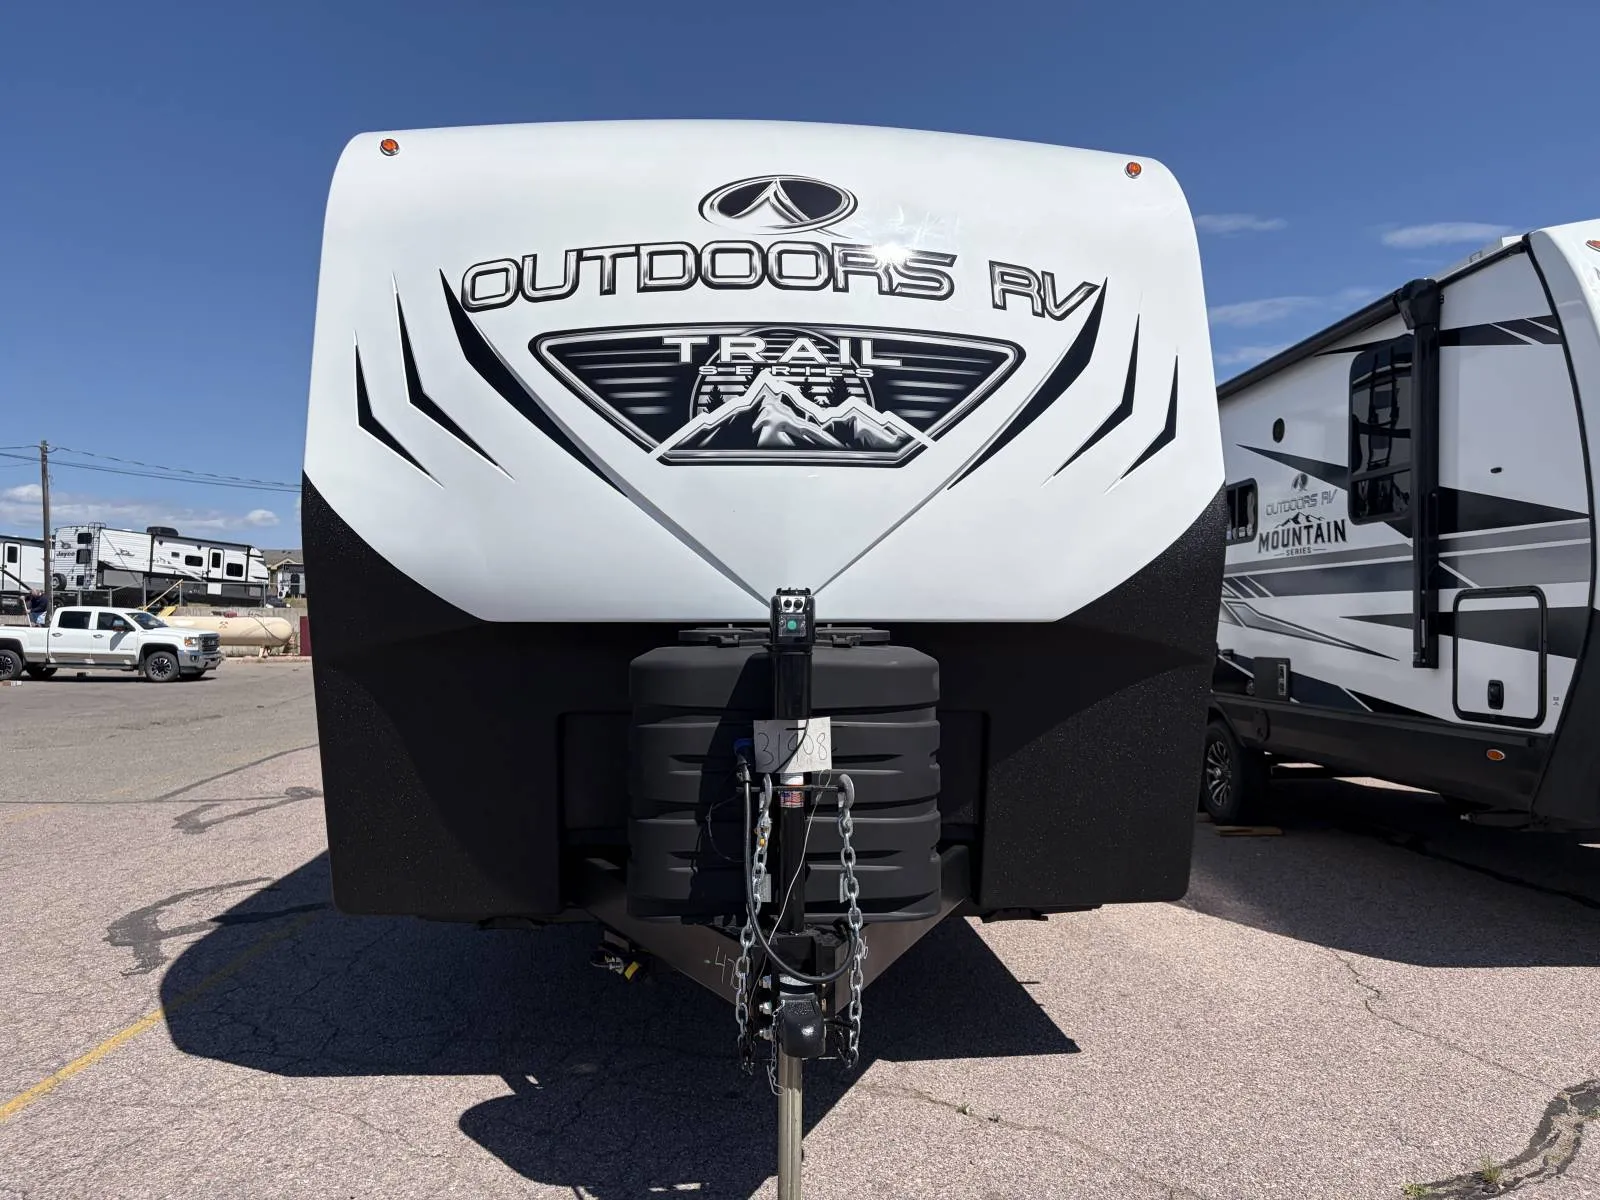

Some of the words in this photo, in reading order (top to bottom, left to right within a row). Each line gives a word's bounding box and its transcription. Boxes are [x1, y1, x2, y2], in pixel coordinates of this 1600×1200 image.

[461, 240, 957, 312] OUTDOORS
[988, 259, 1101, 321] RV
[661, 336, 903, 367] TRAIL
[698, 365, 874, 378] SERIES
[1266, 493, 1318, 516] OUTDOORS
[1321, 489, 1338, 505] RV
[1258, 519, 1348, 553] MOUNTAIN
[1286, 546, 1312, 556] SERIES
